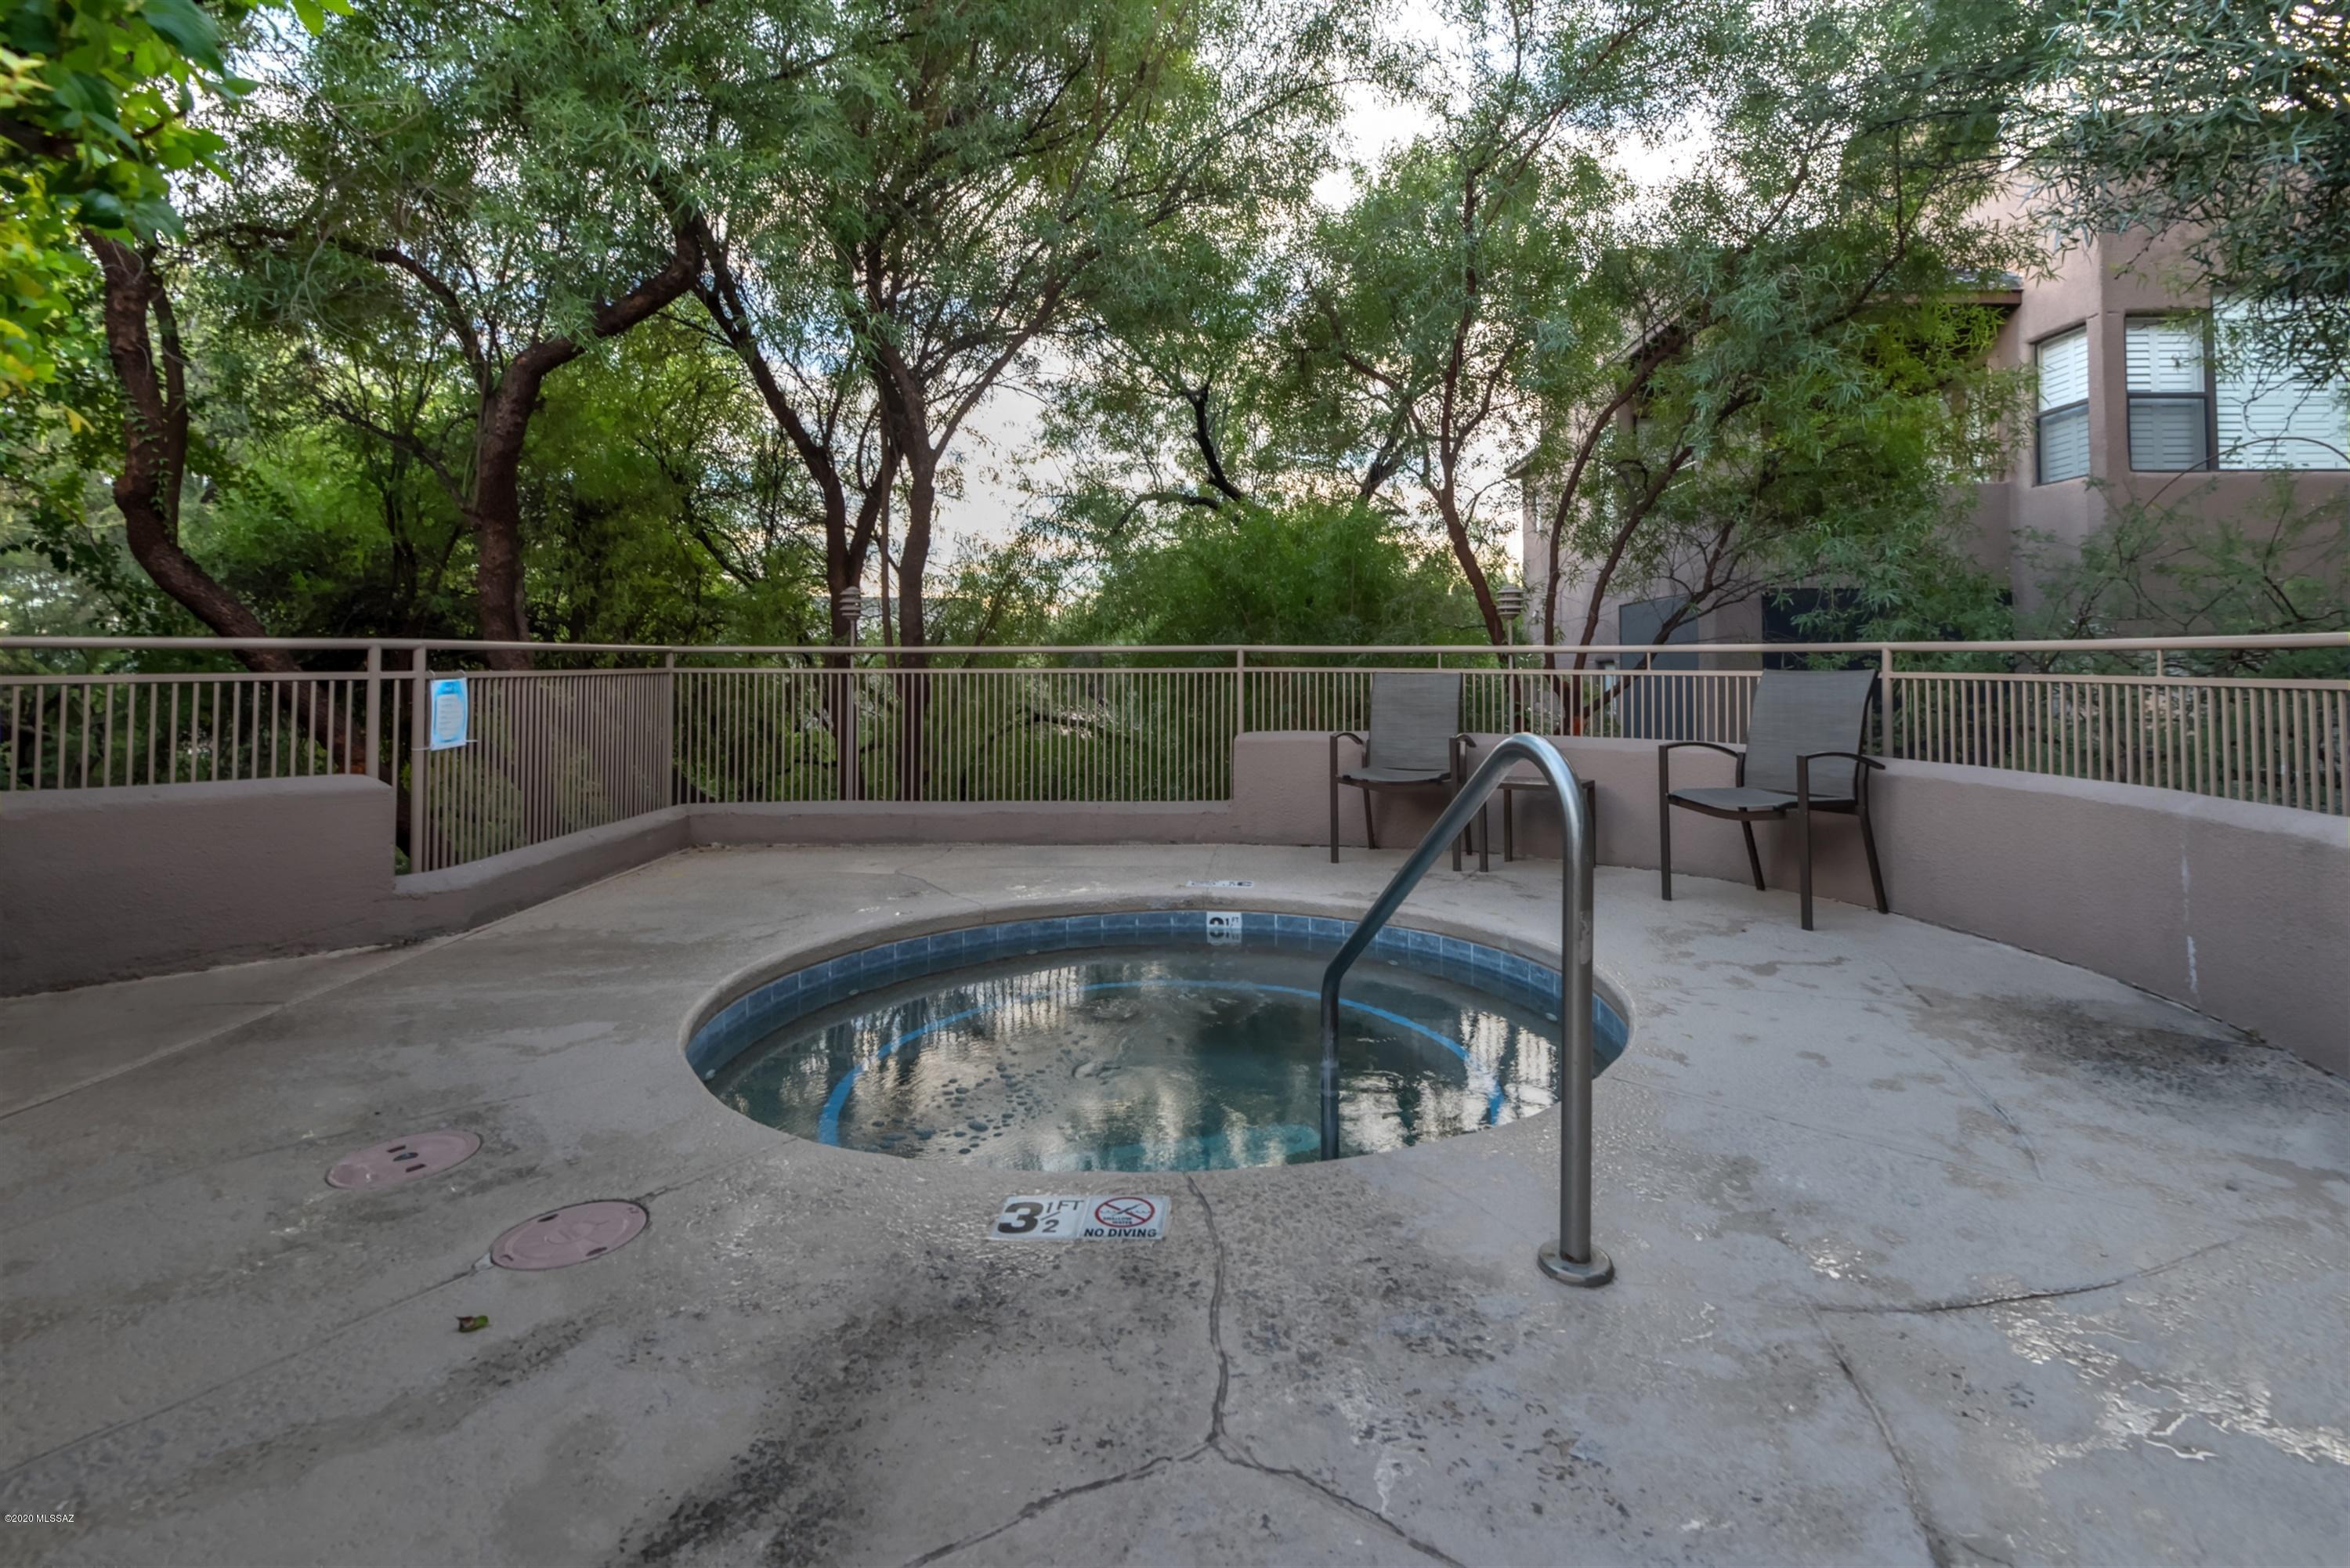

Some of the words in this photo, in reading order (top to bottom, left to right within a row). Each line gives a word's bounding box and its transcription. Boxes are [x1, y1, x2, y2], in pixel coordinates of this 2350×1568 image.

[997, 1201, 1044, 1234] 3
[1057, 1200, 1085, 1211] FT
[1084, 1228, 1104, 1237] NO
[1108, 1228, 1158, 1237] DIVING
